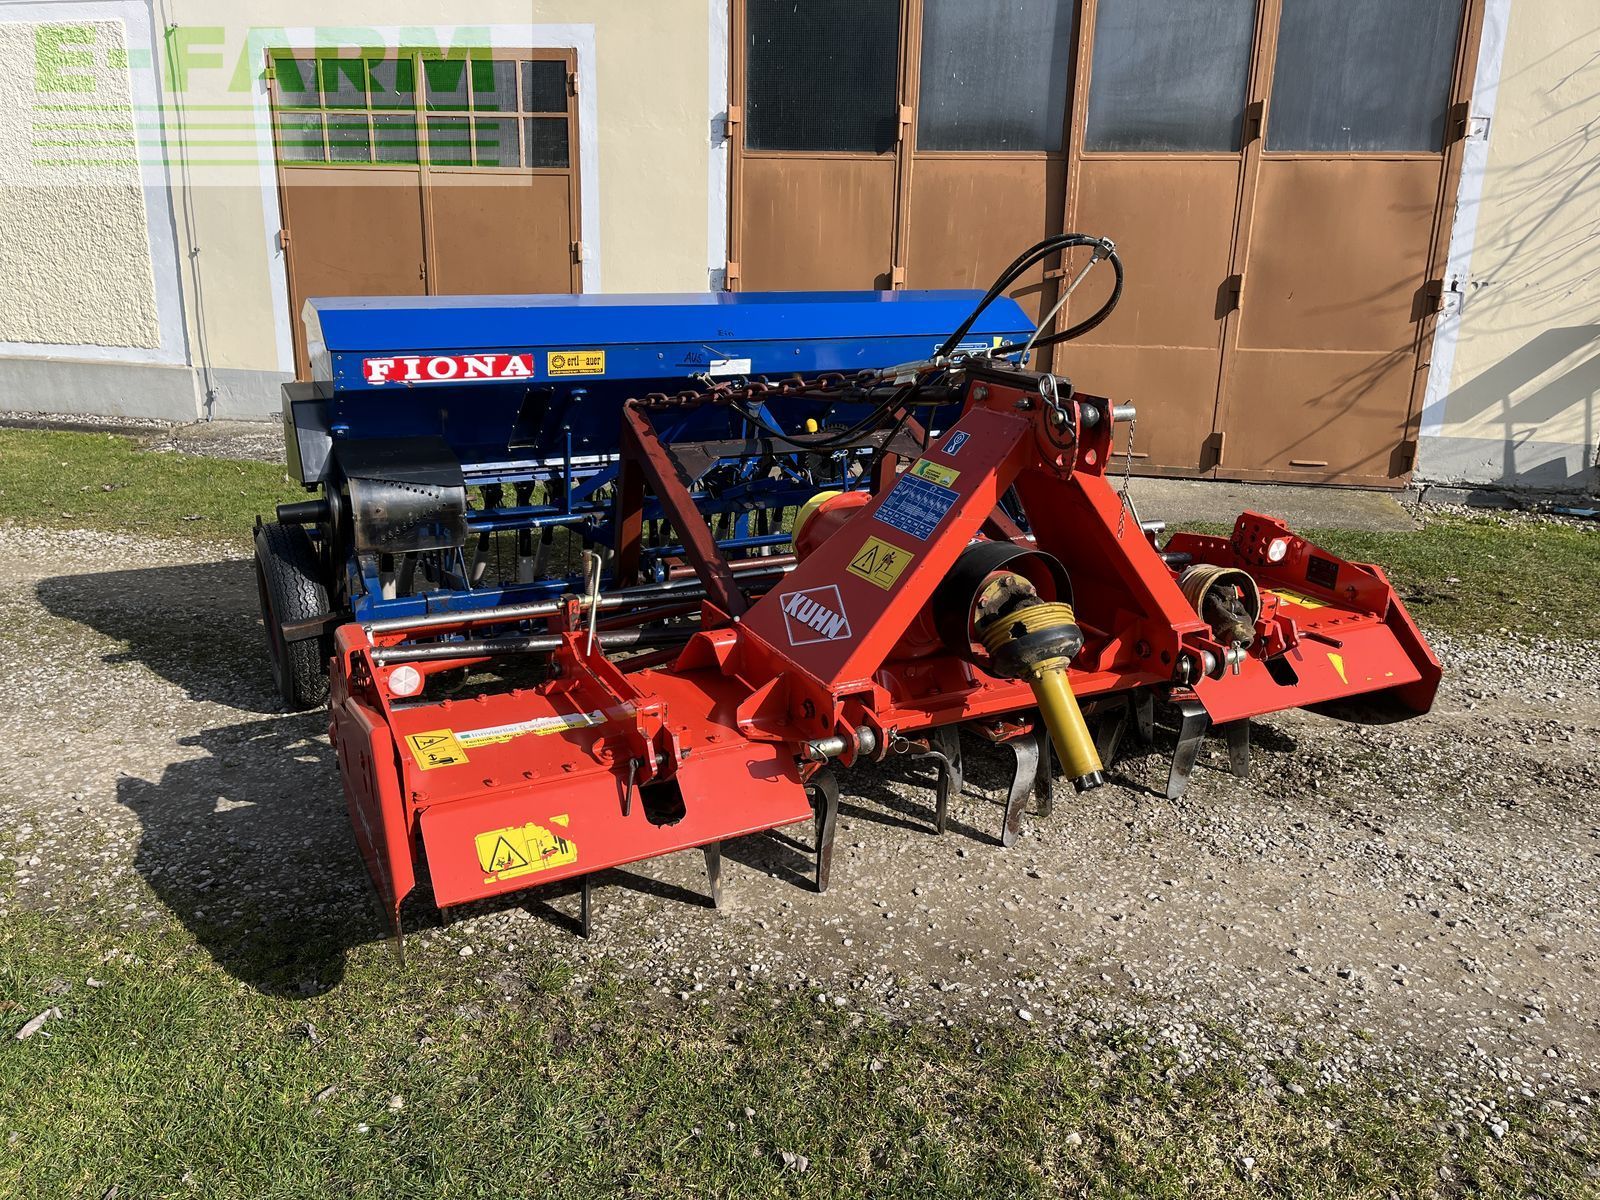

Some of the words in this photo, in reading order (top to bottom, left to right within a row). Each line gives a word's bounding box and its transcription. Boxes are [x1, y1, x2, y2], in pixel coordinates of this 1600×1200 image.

[718, 329, 735, 337] Ein
[367, 355, 532, 381] FIONA
[784, 591, 846, 639] KUHN
